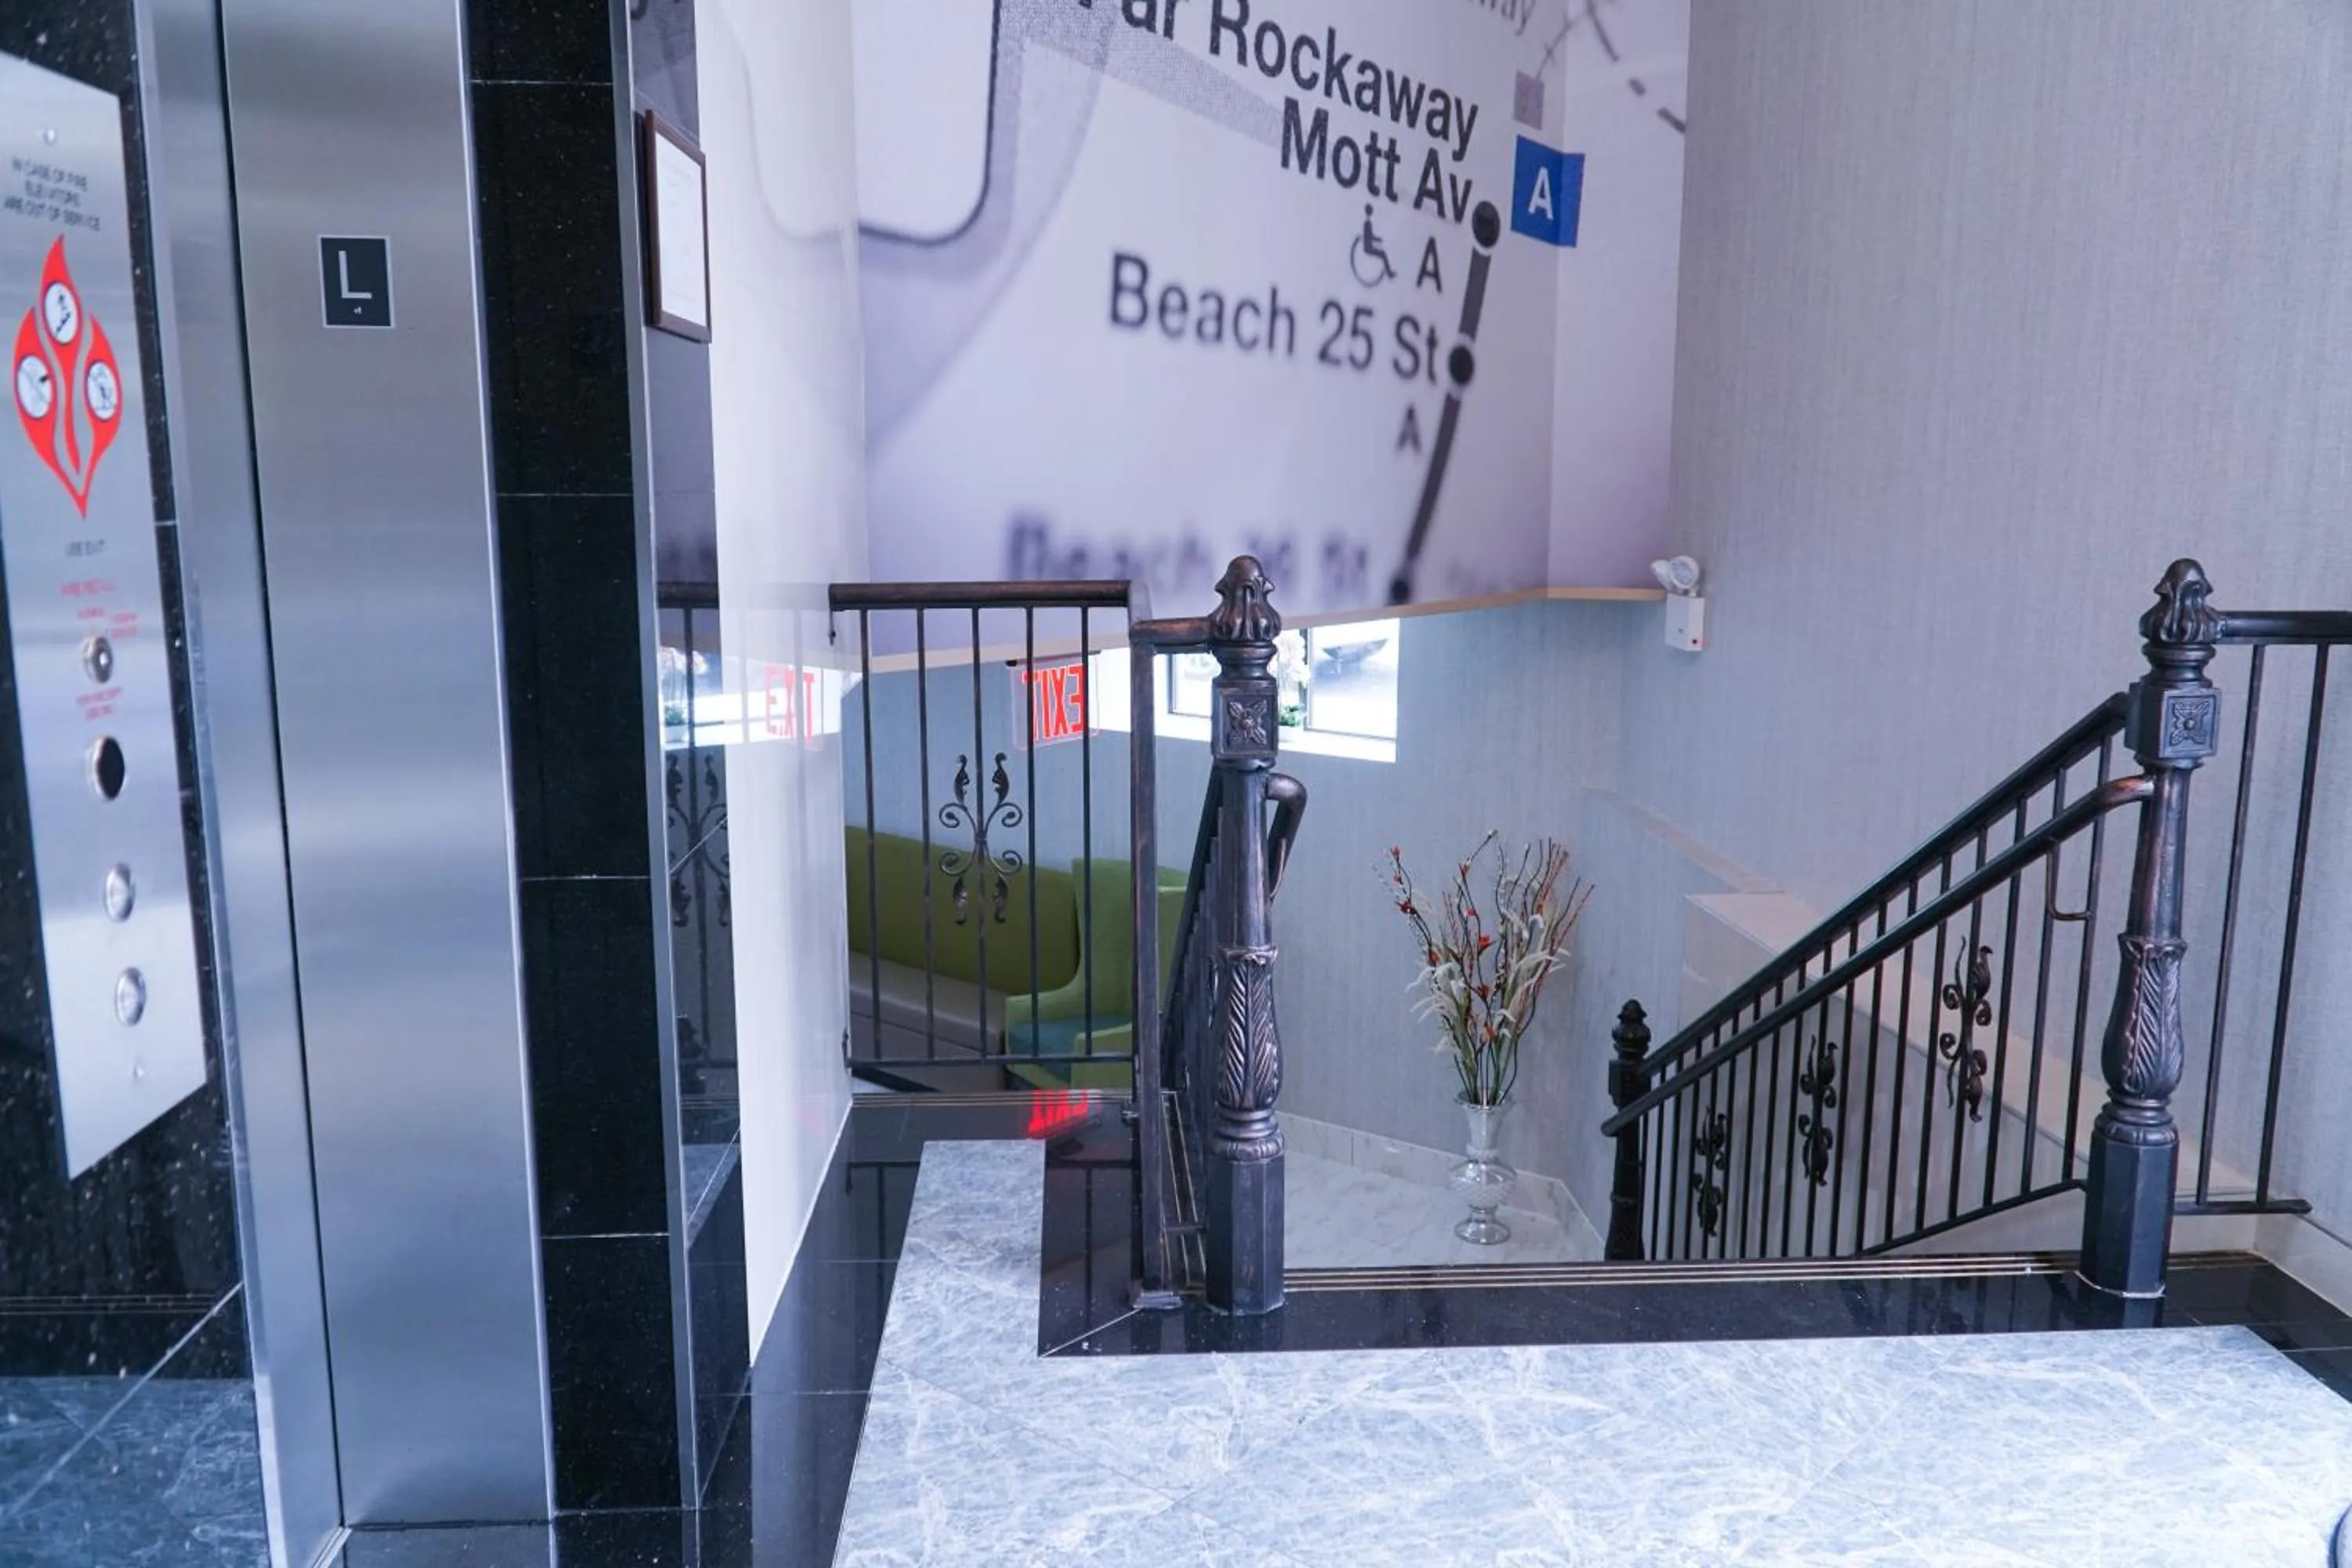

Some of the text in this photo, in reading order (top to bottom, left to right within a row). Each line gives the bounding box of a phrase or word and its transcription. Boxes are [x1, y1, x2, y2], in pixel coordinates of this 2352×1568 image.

[1209, 0, 1479, 162] Rockaway
[1281, 96, 1473, 224] Mott Av
[1528, 167, 1554, 220] A
[338, 250, 372, 299] L
[1416, 236, 1443, 292] A
[1110, 252, 1439, 384] Beach 25 St
[1396, 403, 1421, 454] A
[763, 666, 815, 746] EXT
